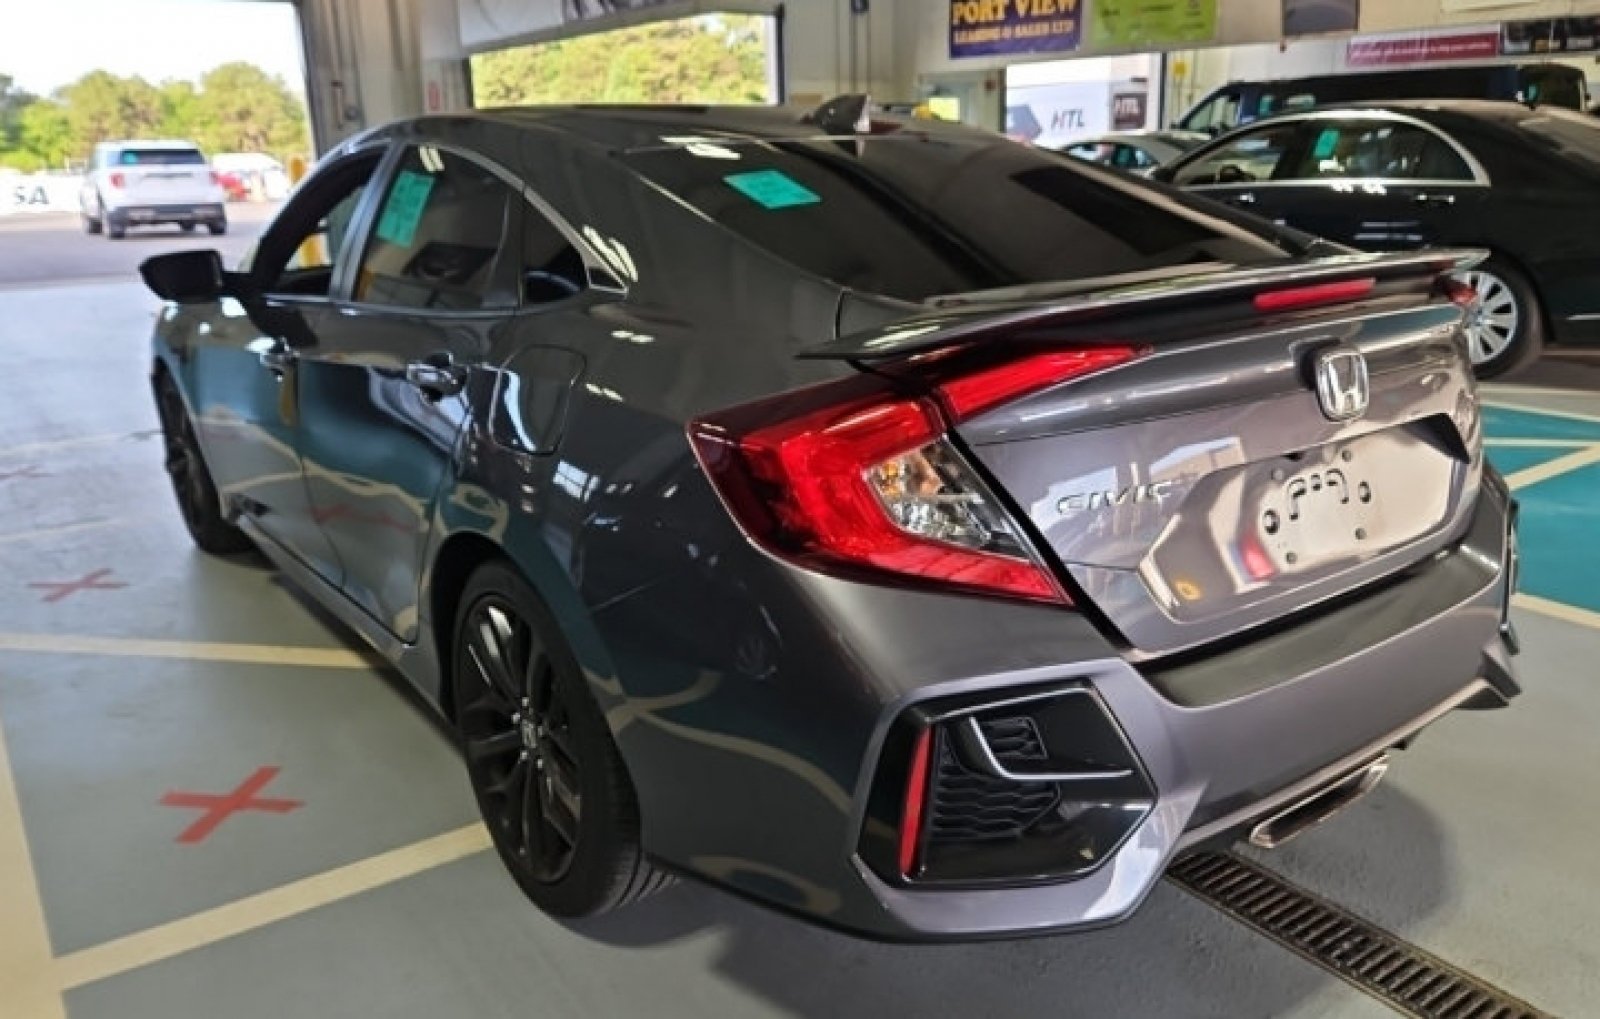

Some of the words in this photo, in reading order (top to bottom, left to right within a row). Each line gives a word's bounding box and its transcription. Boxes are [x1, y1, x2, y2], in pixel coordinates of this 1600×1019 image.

[952, 0, 1008, 25] PORT
[1014, 0, 1076, 19] VIEW
[1056, 480, 1172, 513] CIVIC
